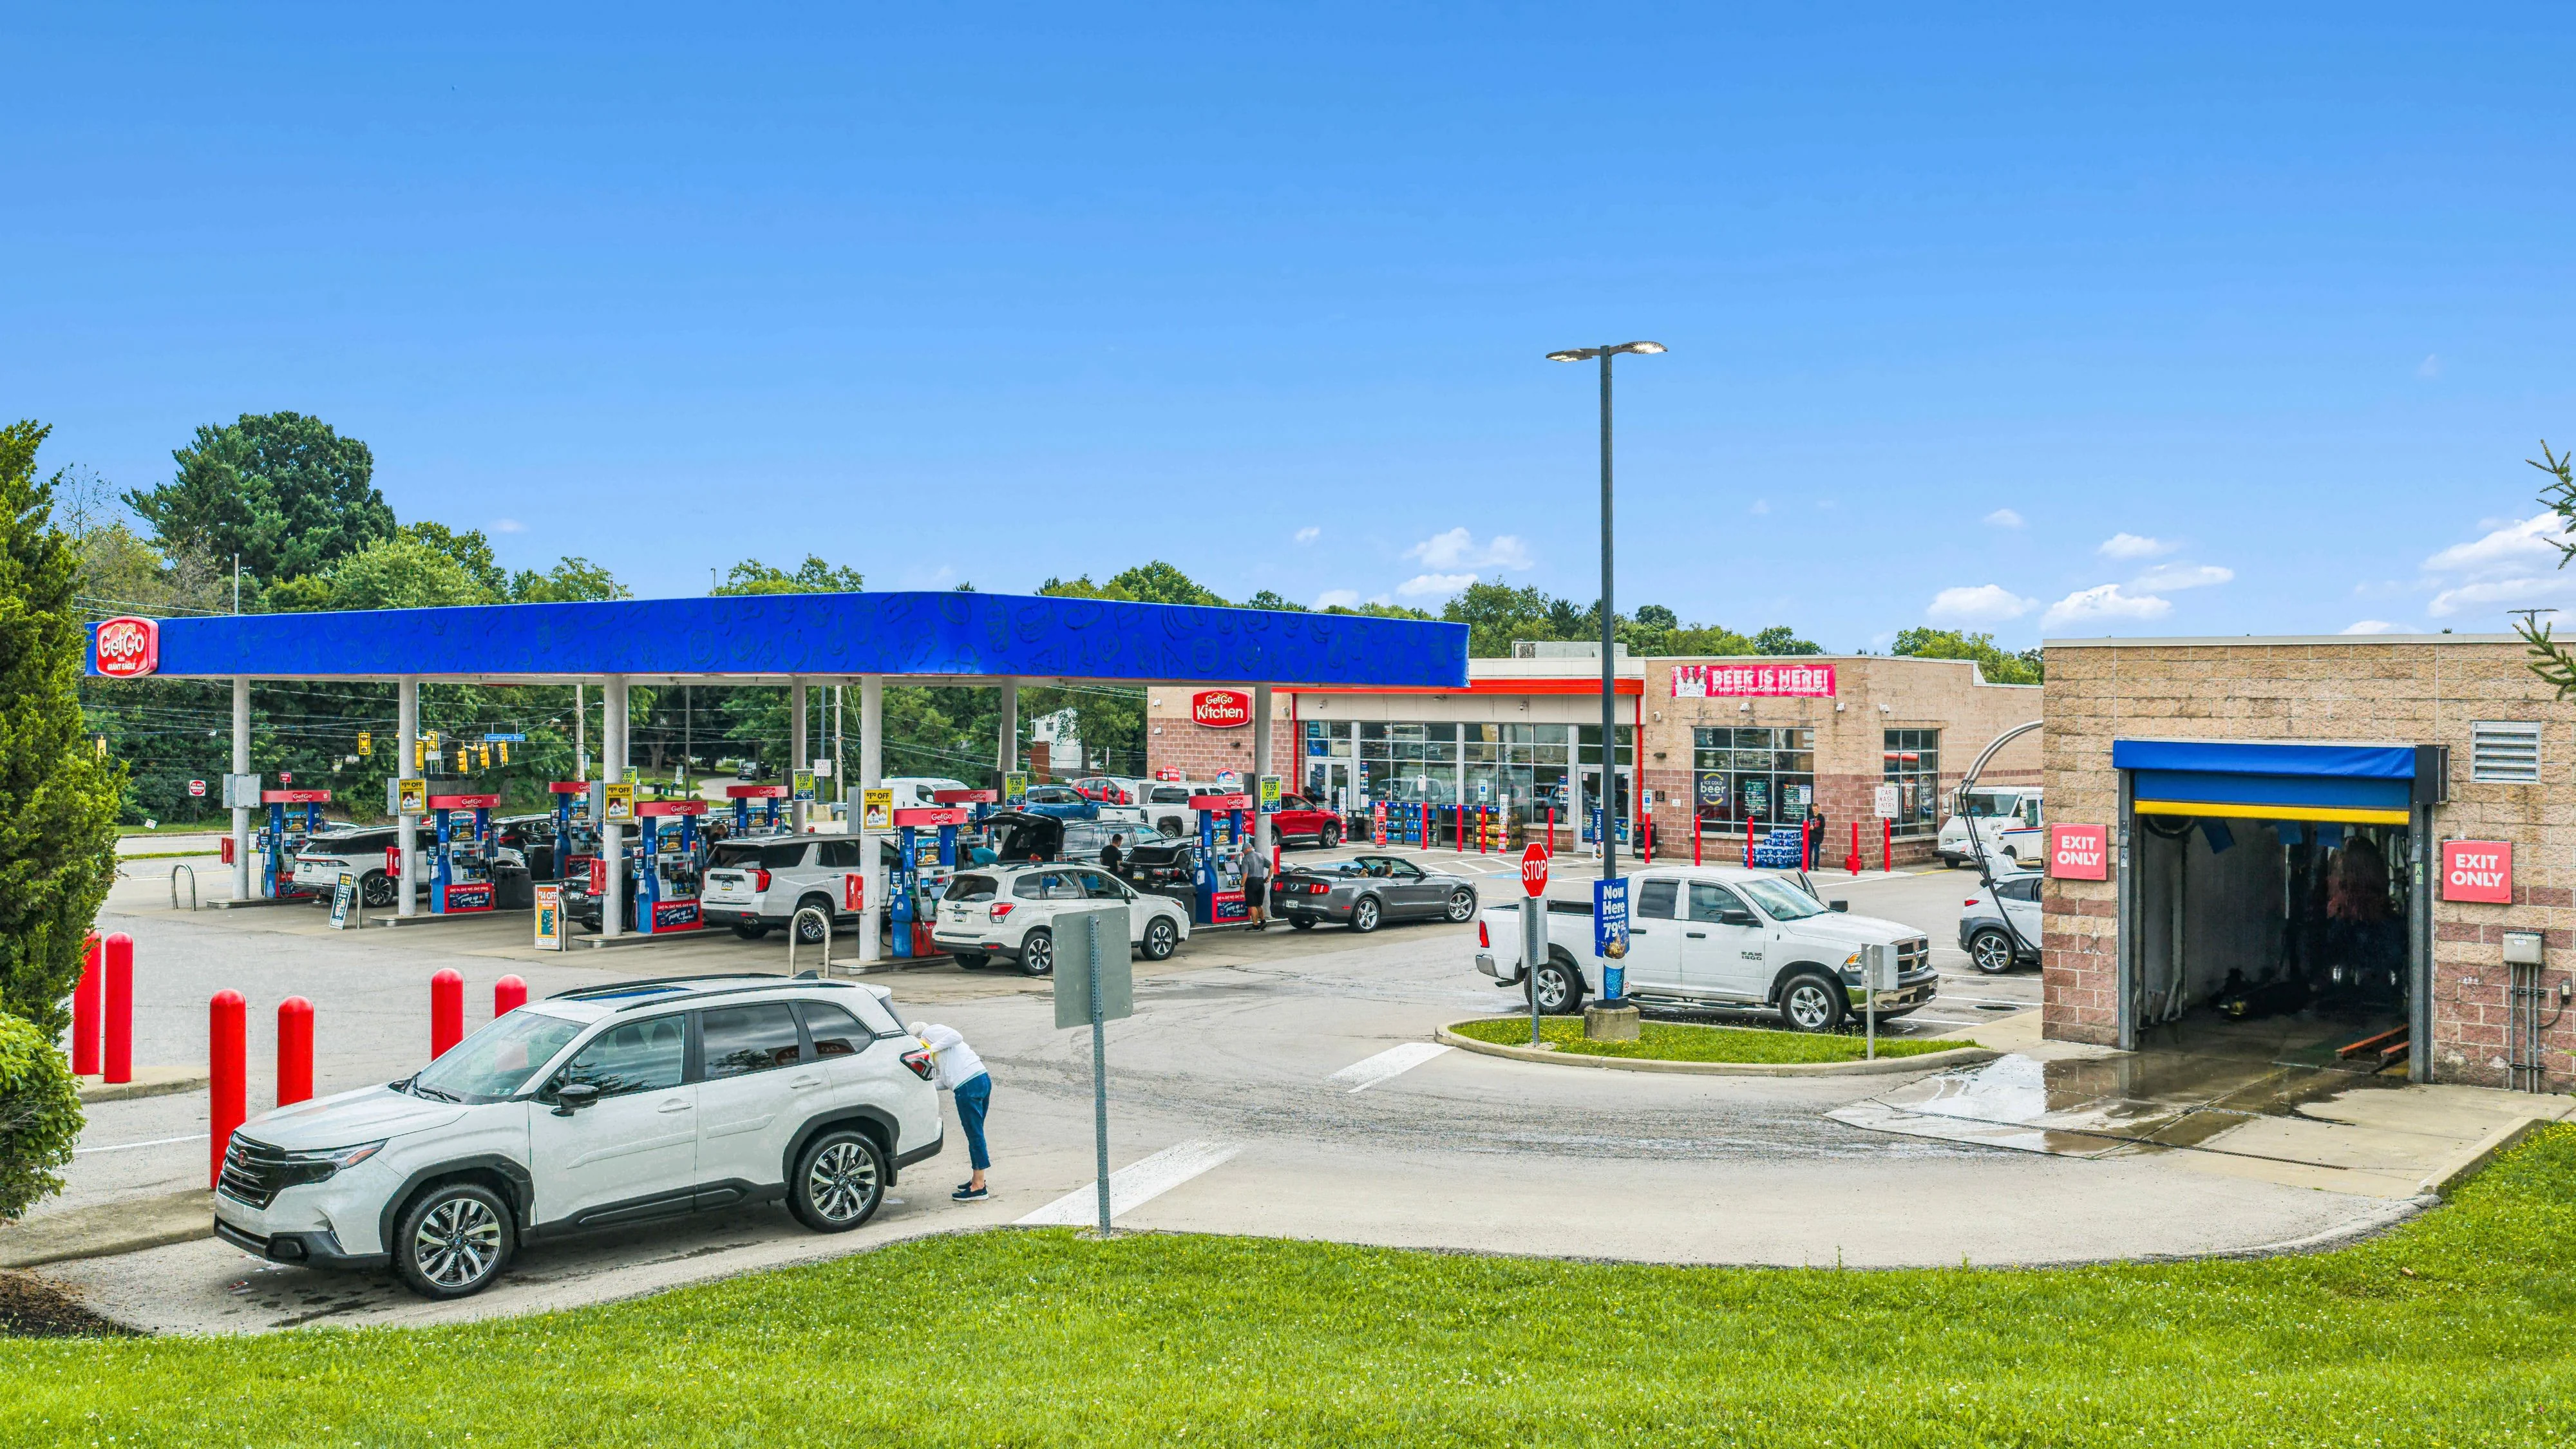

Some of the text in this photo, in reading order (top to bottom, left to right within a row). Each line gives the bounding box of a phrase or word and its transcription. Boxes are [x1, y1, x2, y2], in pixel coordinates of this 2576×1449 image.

[99, 629, 144, 657] GetGo
[1713, 670, 1828, 685] BEER IS HERE!
[1206, 695, 1233, 704] GetGo
[1197, 704, 1244, 719] Kitchen
[1701, 782, 1726, 793] beer
[2062, 836, 2096, 849] EXIT
[2058, 851, 2101, 866] ONLY
[2456, 854, 2498, 869] EXIT
[1524, 860, 1546, 881] STOP
[2450, 871, 2503, 887] ONLY
[339, 884, 350, 894] FREE
[1604, 886, 1624, 900] Now
[1603, 901, 1625, 914] Here
[668, 912, 681, 921] pump
[1607, 971, 1621, 983] Polar
